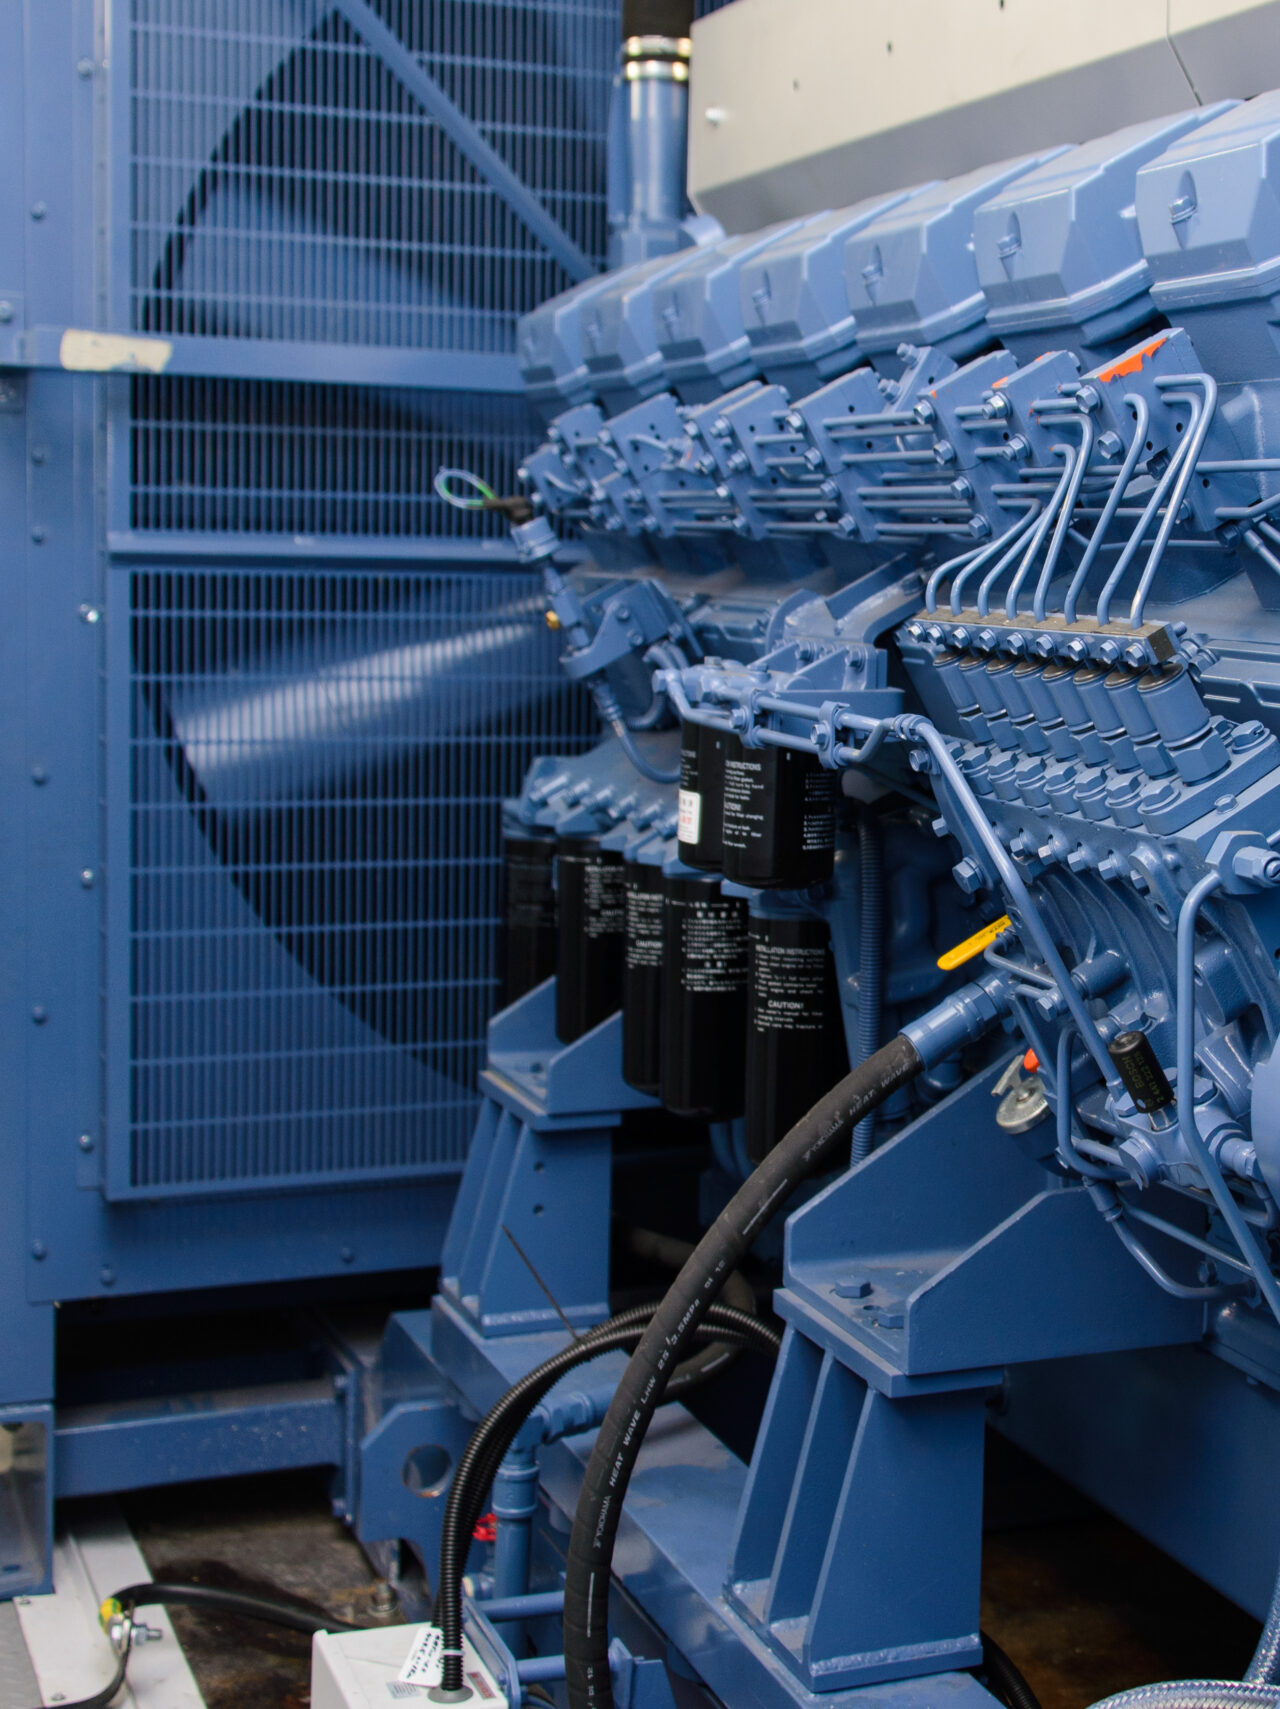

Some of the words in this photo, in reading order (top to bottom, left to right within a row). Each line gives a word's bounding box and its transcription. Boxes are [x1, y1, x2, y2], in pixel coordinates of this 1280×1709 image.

[848, 1090, 874, 1116] HEAT
[880, 1062, 909, 1088] WAVE
[1120, 1055, 1145, 1089] BOSCH
[608, 1453, 625, 1488] HEAT
[622, 1409, 641, 1446] WAVE
[640, 1375, 657, 1404] LHW
